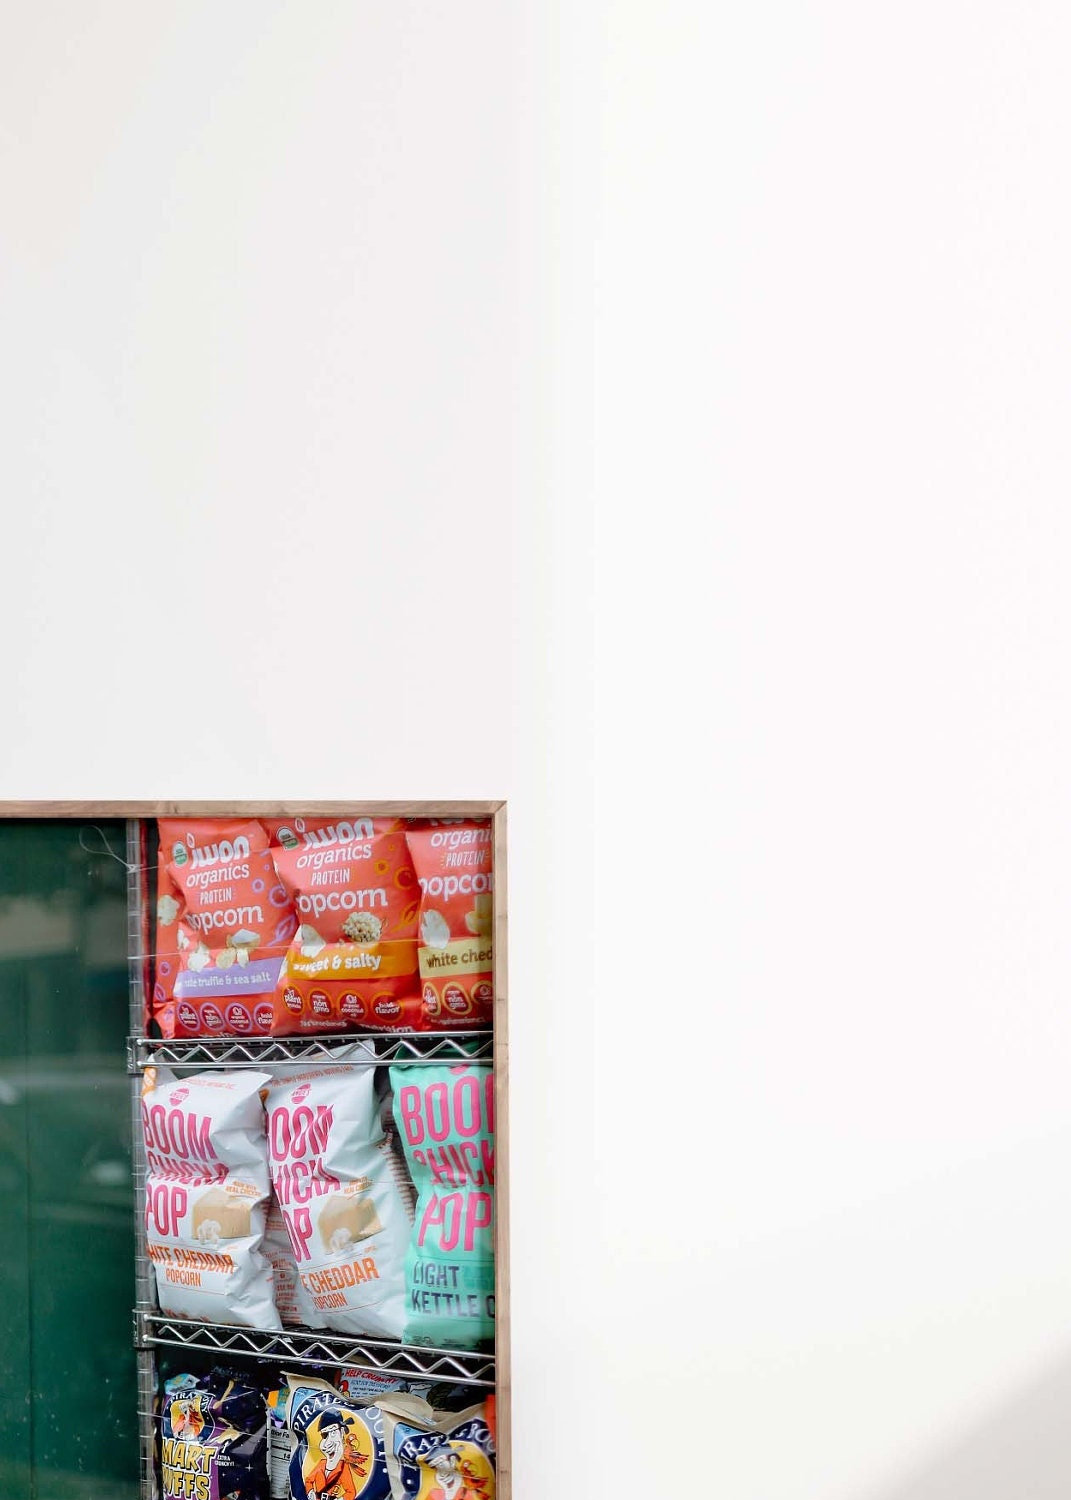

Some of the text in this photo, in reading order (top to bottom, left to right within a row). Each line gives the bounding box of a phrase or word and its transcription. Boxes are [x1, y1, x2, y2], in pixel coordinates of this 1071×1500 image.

[296, 842, 372, 870] organics
[445, 850, 485, 867] PROTEIN
[186, 863, 250, 889] organics
[311, 868, 350, 886] PROTEIN
[200, 888, 232, 906] PROTEIN
[296, 888, 388, 918] opcorn
[331, 955, 342, 970] &
[344, 953, 382, 971] salty
[426, 953, 458, 968] white
[251, 971, 271, 983] salt
[401, 1076, 494, 1146] BOO
[266, 1104, 334, 1162] OOM
[418, 1192, 493, 1251] POP
[174, 1248, 234, 1274] CHEDDAR
[413, 1261, 459, 1287] LIGHT
[166, 1268, 201, 1287] POPCORN
[309, 1257, 380, 1294] CHEDDAR
[412, 1289, 481, 1317] KETTLE
[163, 1438, 218, 1474] MART
